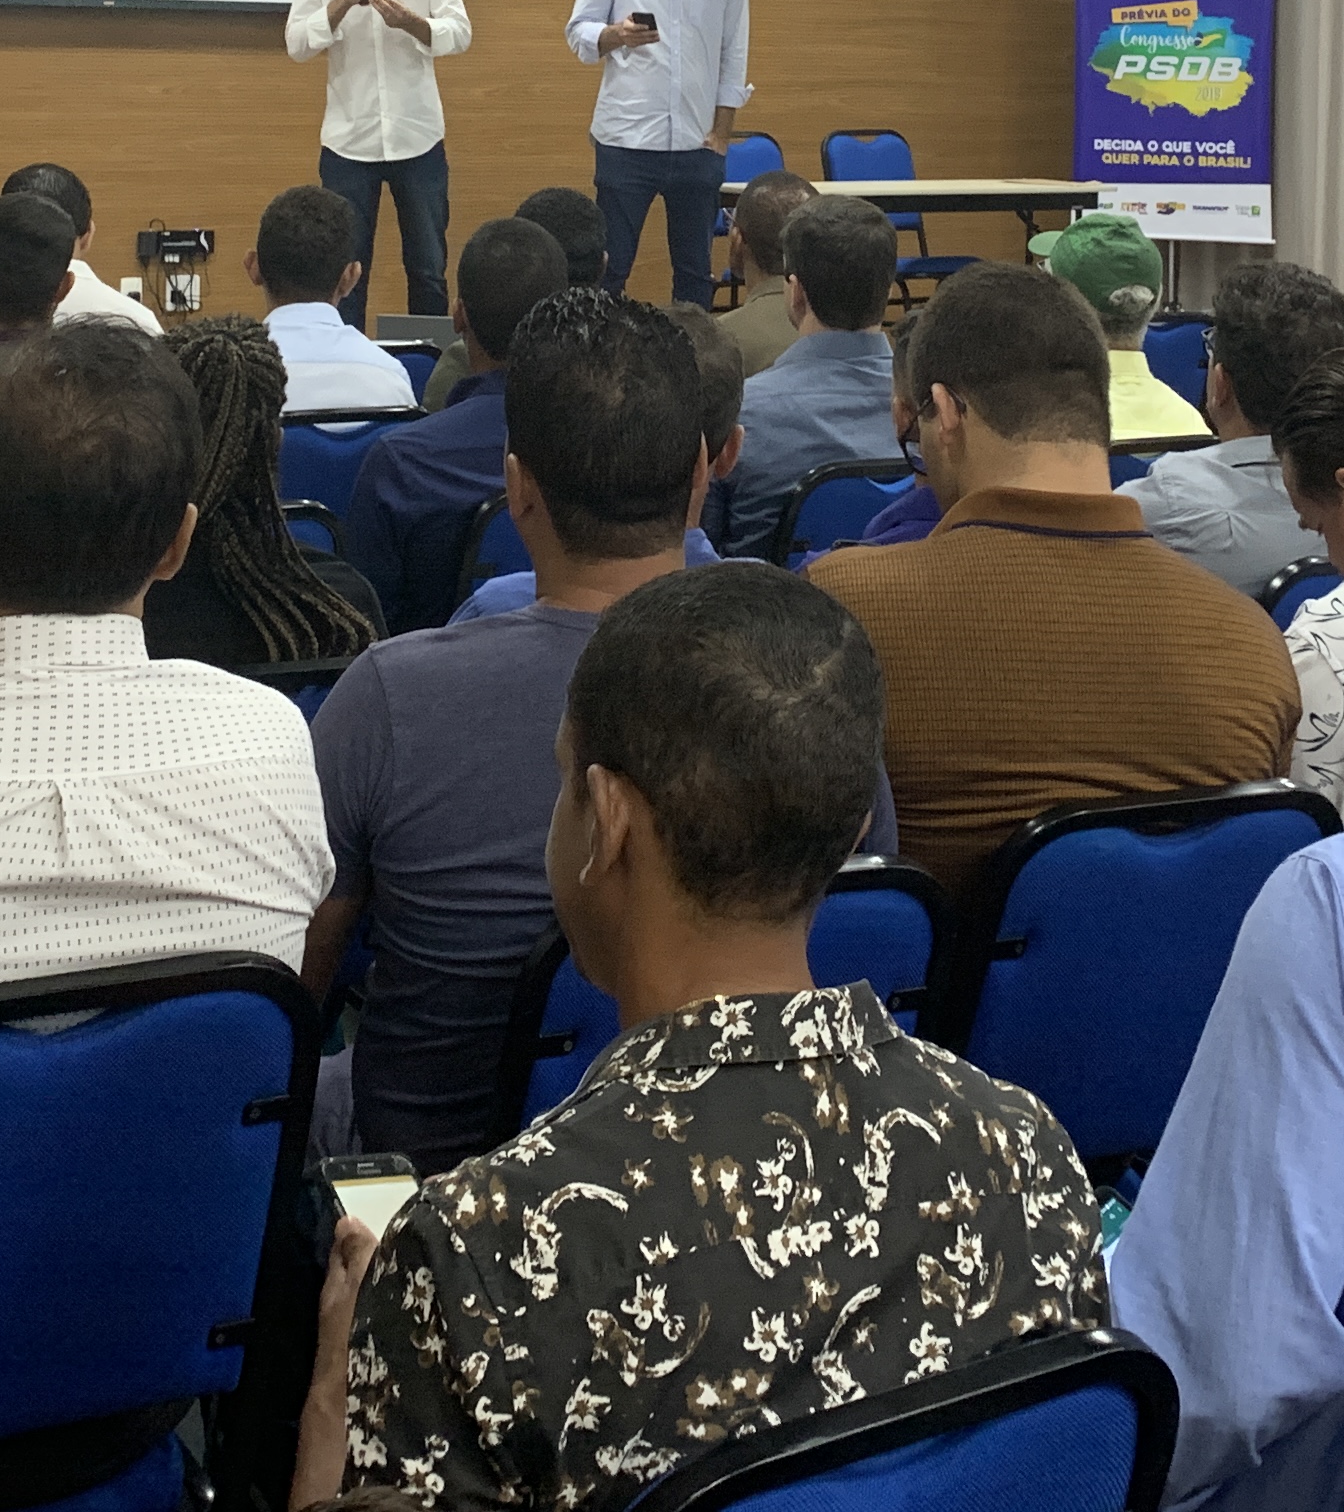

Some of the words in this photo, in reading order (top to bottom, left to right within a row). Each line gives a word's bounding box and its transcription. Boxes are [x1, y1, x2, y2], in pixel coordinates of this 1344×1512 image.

[1172, 7, 1191, 18] DO
[1119, 25, 1197, 54] Congresso
[1113, 54, 1242, 83] PSDB
[1093, 138, 1144, 152] DECIDA
[1147, 140, 1159, 152] O
[1162, 140, 1192, 153] QUE
[1195, 139, 1236, 155] VOCÊ
[1102, 152, 1140, 165] QUER
[1143, 153, 1180, 166] PARA
[1183, 155, 1195, 167] O
[1198, 155, 1252, 169] BRASIL!
